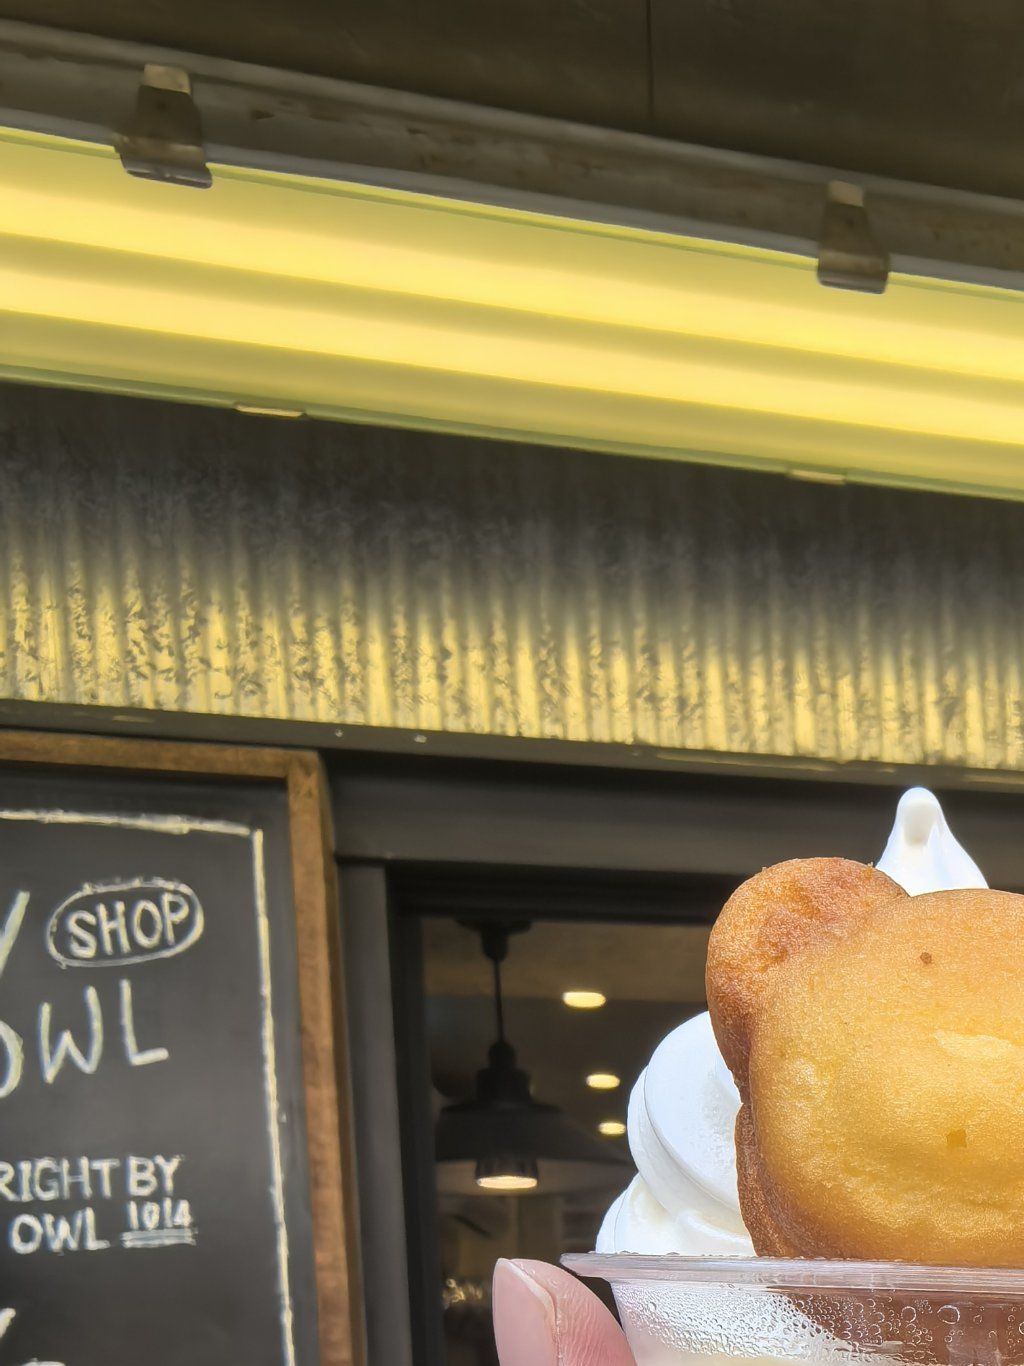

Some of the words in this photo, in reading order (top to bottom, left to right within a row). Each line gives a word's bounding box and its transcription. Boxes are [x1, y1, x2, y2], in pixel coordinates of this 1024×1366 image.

[67, 892, 190, 959] SHOP
[127, 1154, 185, 1197] BY
[10, 1206, 111, 1255] OWL
